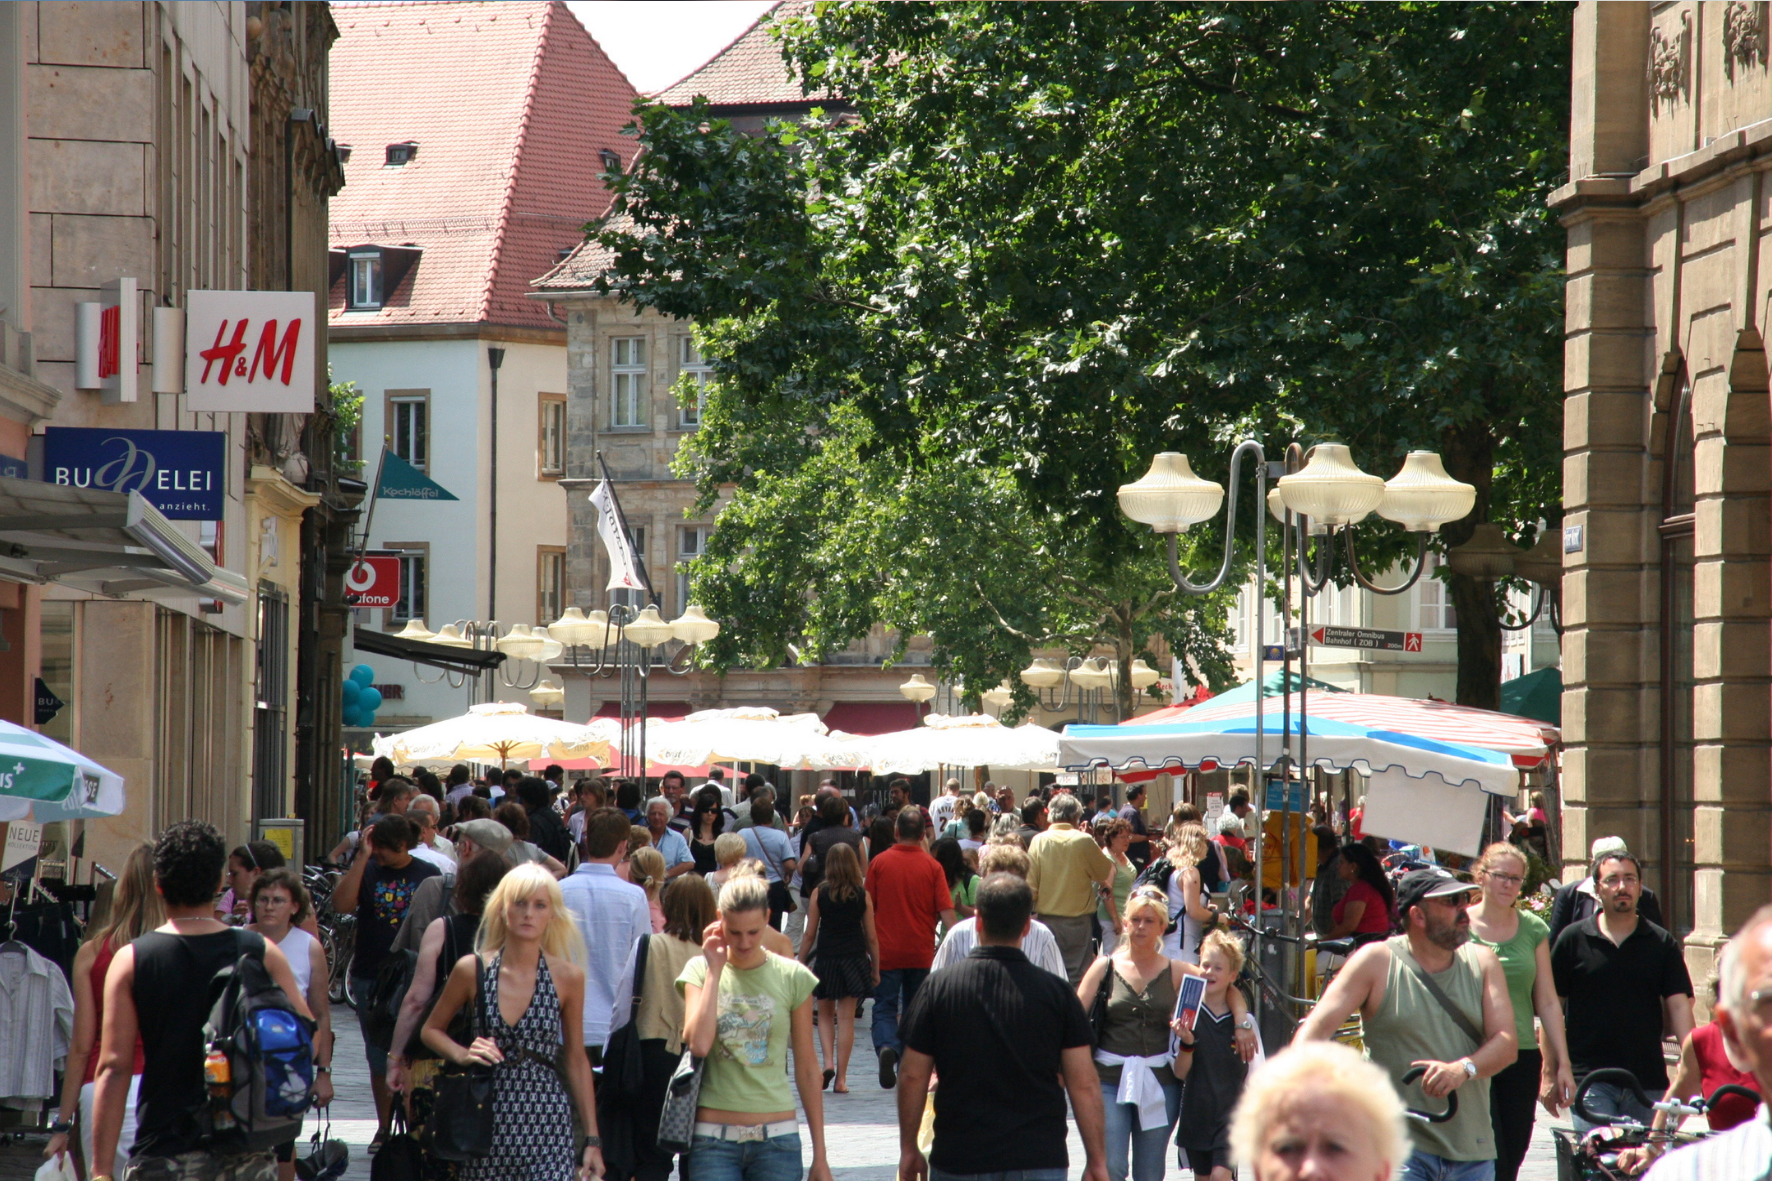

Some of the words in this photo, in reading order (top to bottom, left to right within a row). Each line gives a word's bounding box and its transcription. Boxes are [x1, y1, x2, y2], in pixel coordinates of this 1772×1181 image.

[200, 318, 301, 386] H&M
[382, 487, 439, 499] Kochlöffel
[159, 502, 211, 511] anzieht.
[1326, 628, 1355, 637] Zentraler
[1357, 631, 1385, 640] Omnibus
[1325, 637, 1352, 645] Bahnhof
[9, 827, 39, 842] NEUE
